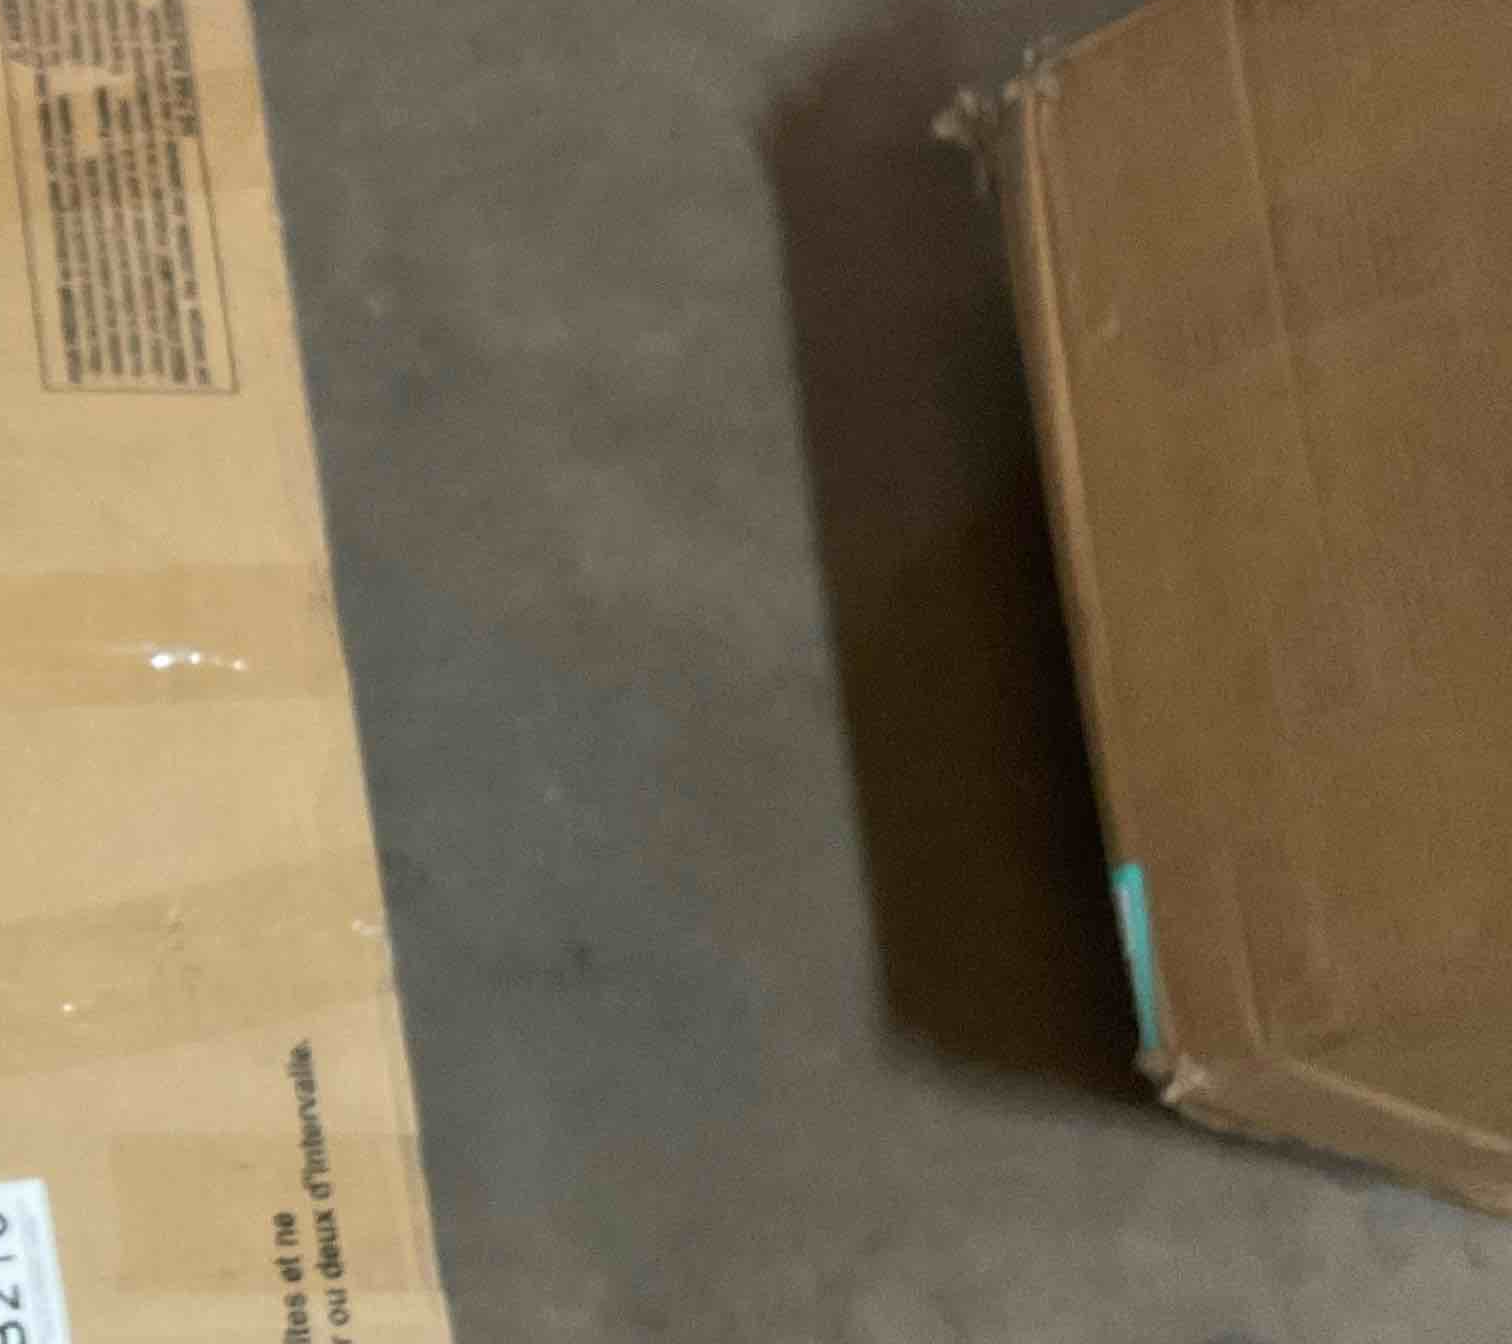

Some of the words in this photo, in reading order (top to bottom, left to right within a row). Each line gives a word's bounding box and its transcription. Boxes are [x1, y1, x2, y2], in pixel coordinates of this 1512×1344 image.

[272, 1211, 299, 1248] ne
[314, 1208, 345, 1281] deux
[273, 1255, 304, 1285] et
[325, 1287, 352, 1328] ou
